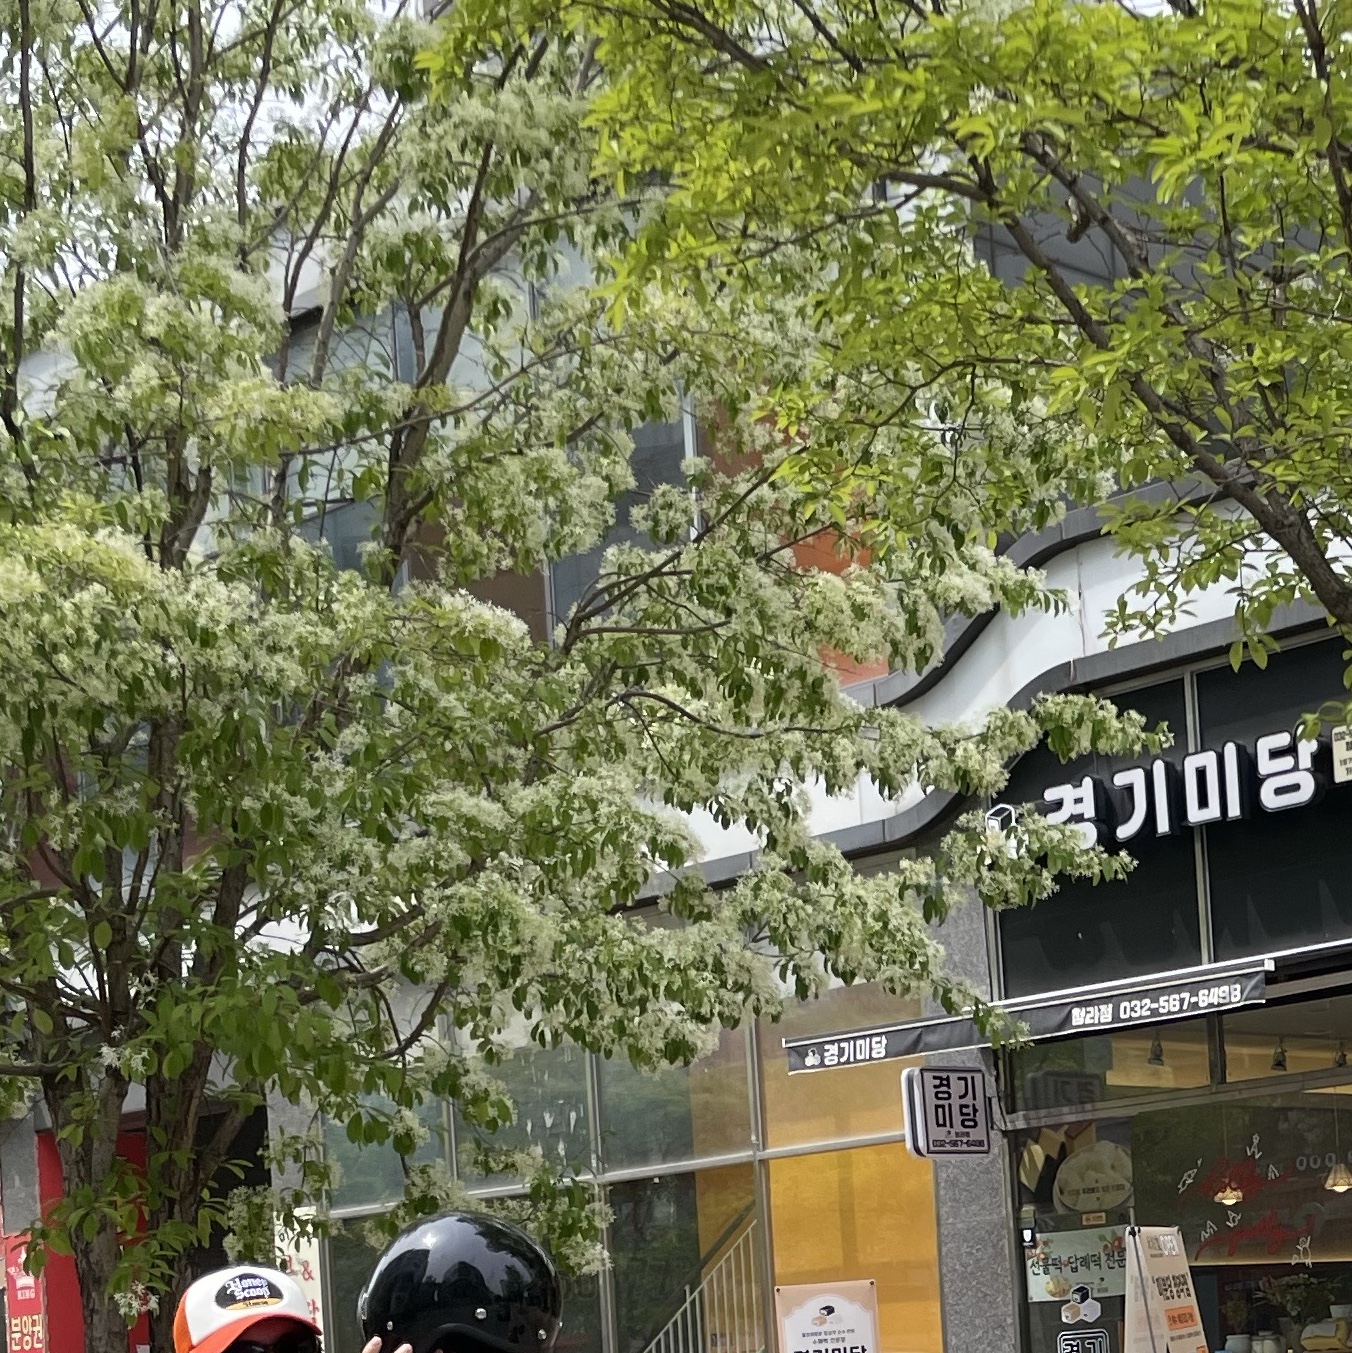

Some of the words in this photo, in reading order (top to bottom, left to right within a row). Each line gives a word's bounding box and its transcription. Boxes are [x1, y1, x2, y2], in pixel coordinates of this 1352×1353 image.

[1043, 725, 1319, 850] 경기미당
[1119, 985, 1242, 1019] 032-567-6498
[823, 1036, 887, 1067] 경기미당
[932, 1074, 977, 1101] 경기
[934, 1102, 979, 1129] 미당
[225, 1277, 269, 1295] Honey
[234, 1286, 271, 1300] Scoop
[10, 1316, 44, 1352] 분양권
